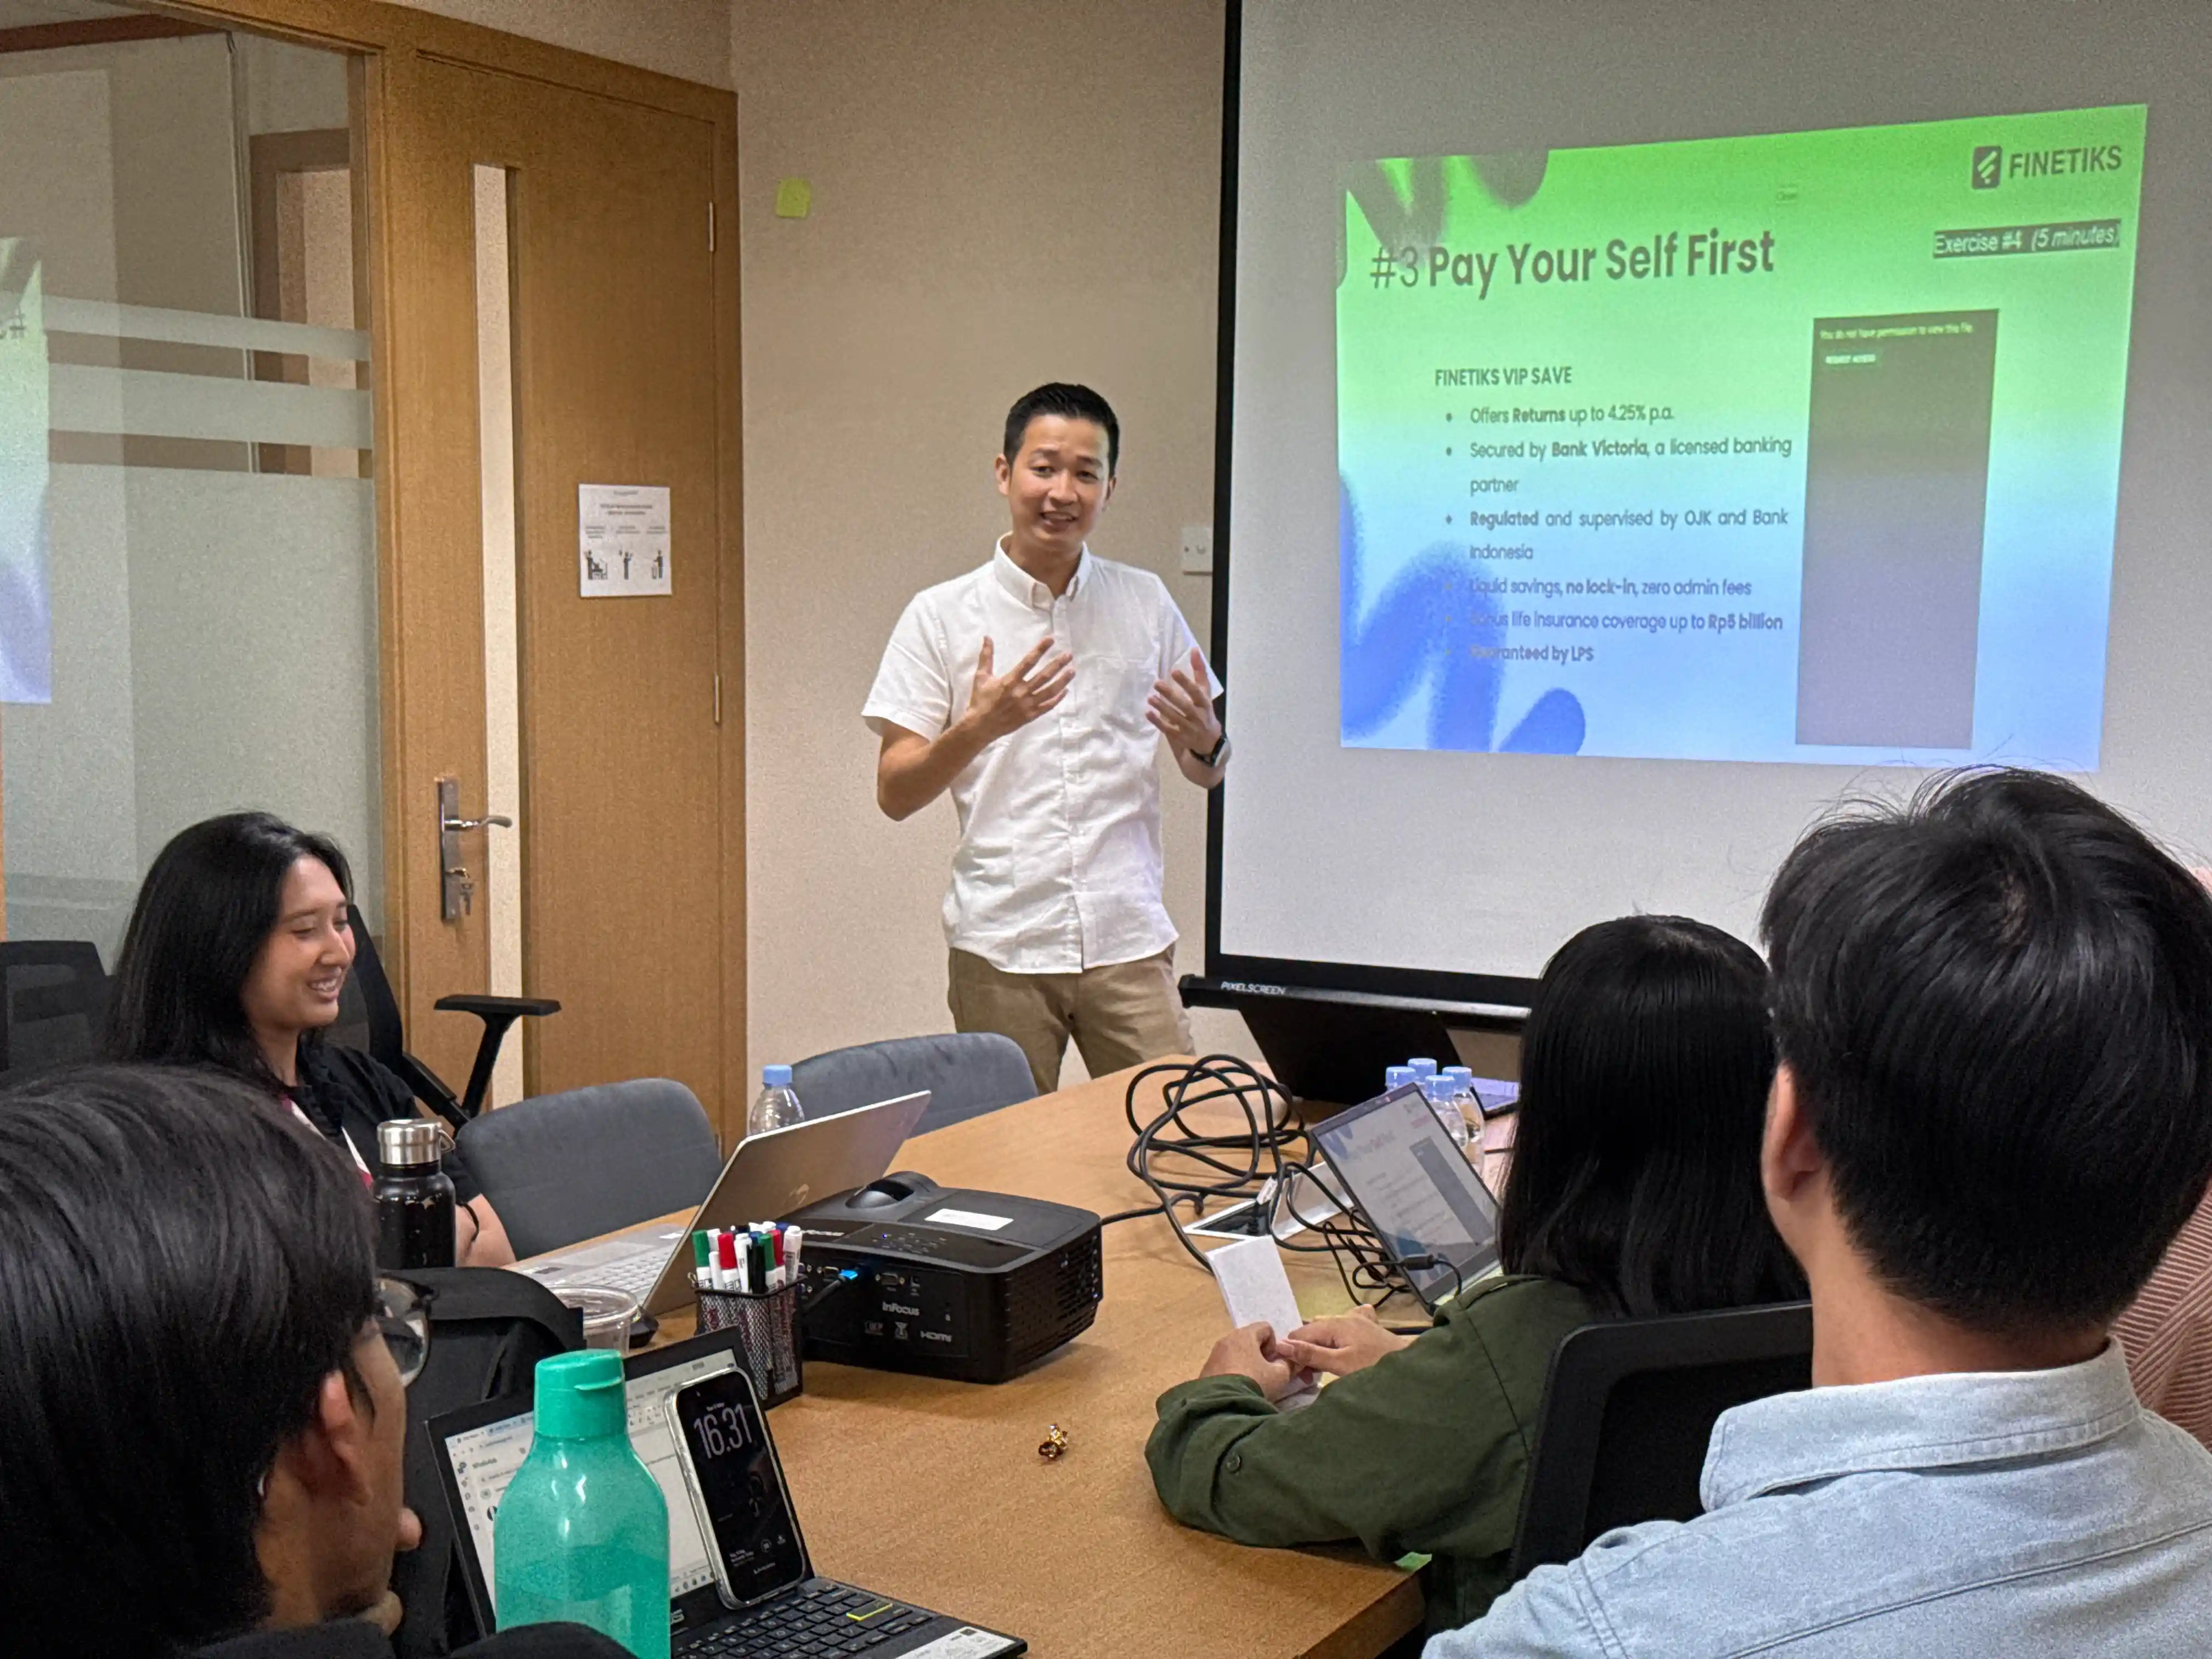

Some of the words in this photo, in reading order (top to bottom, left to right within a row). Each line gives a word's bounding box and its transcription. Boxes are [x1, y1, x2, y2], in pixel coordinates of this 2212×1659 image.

[2009, 145, 2122, 178] FINETIKS
[1934, 233, 1999, 254] Exercise
[1369, 246, 1419, 289] #3
[1429, 246, 1499, 300] Pay
[1506, 243, 1596, 284] Your
[1606, 230, 1678, 280] Self
[1688, 227, 1775, 276] First
[1435, 368, 1500, 387] FINETIKS
[1503, 367, 1528, 386] VIP
[1531, 365, 1573, 385] SAVE
[1470, 407, 1509, 424] Offers
[1512, 407, 1566, 424] Returns
[1568, 408, 1588, 427] up
[1590, 405, 1605, 422] to
[1470, 441, 1525, 458] Secured
[1530, 441, 1547, 463] by
[1551, 440, 1588, 458] Bank
[1655, 442, 1666, 456] a
[1670, 437, 1729, 455] licensed
[1733, 436, 1792, 458] banking
[1470, 478, 1520, 497] partner
[1470, 509, 1539, 531] Regulated
[1545, 510, 1572, 527] and
[1579, 508, 1654, 532] supervised
[1660, 509, 1678, 531] by
[1684, 509, 1712, 526] OJK
[1718, 509, 1747, 526] and
[1753, 507, 1788, 525] Bank
[1470, 543, 1534, 560] Indonesia
[1510, 577, 1564, 599] savings,
[1566, 581, 1584, 595] no
[1641, 582, 1671, 595] zero
[1673, 577, 1720, 595] admin
[1722, 578, 1752, 596] fees
[1511, 611, 1532, 627] life
[1534, 611, 1599, 629] insurance
[1601, 614, 1667, 634] coverage
[1669, 614, 1689, 634] up
[1691, 613, 1706, 630] to
[1738, 612, 1784, 630] billion
[1551, 645, 1569, 666] by
[1571, 645, 1595, 662] LPS
[1220, 980, 1287, 995] PIXELSCREEN
[882, 1300, 921, 1316] InFocus
[693, 1403, 753, 1459] 16.31
